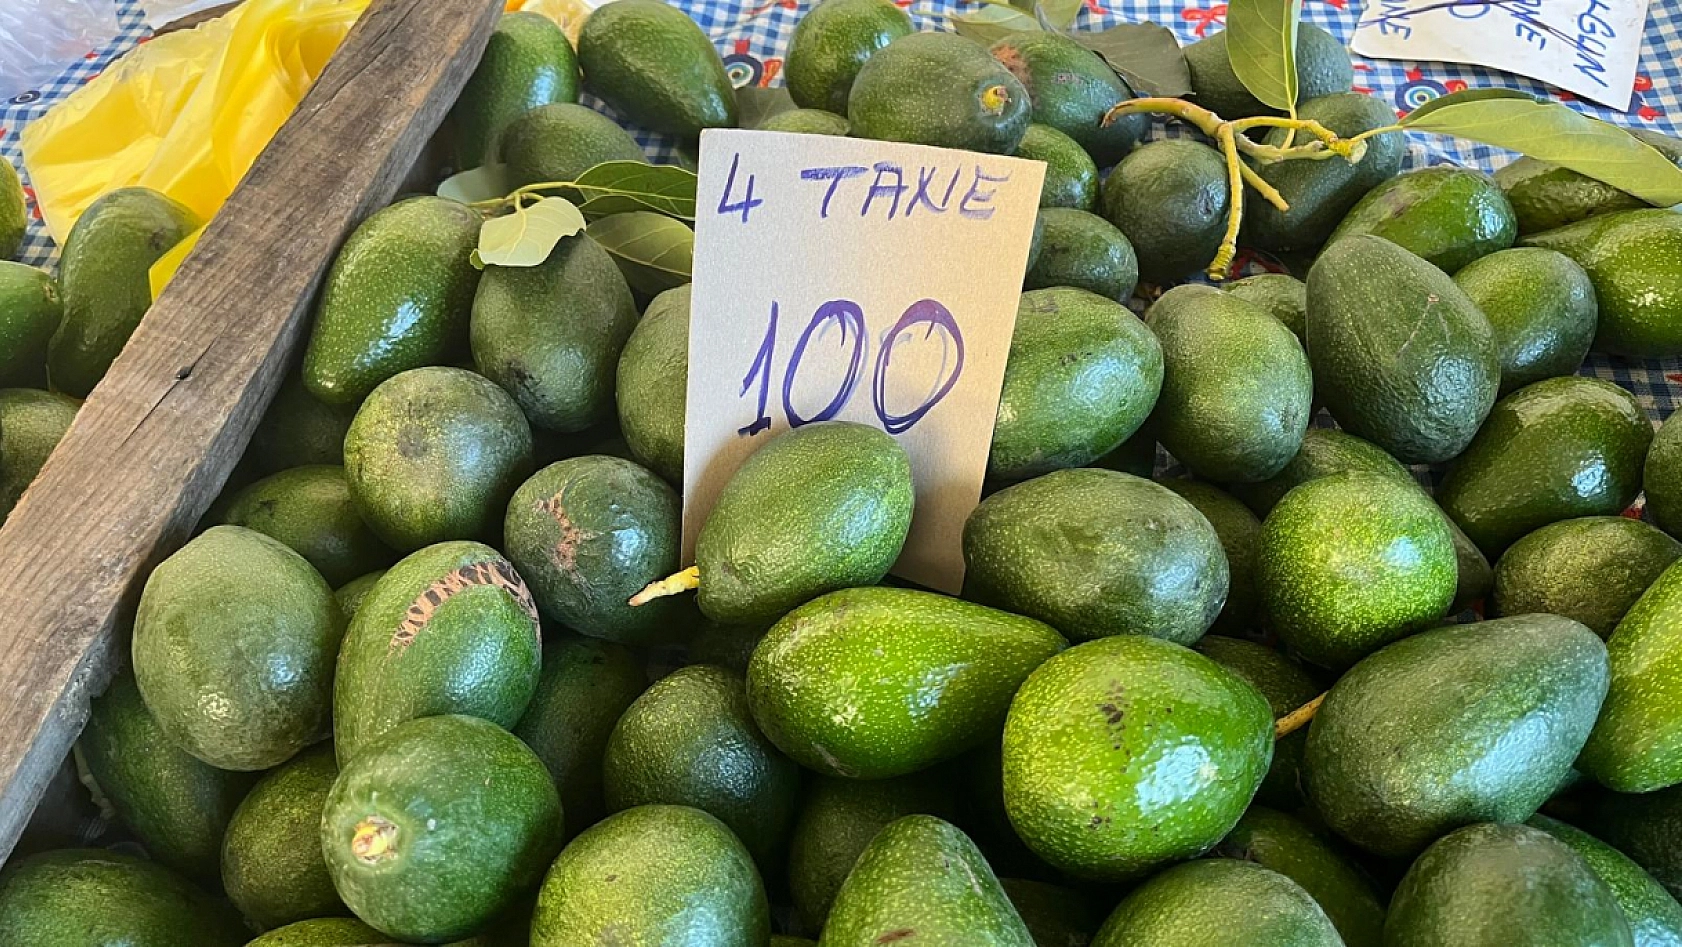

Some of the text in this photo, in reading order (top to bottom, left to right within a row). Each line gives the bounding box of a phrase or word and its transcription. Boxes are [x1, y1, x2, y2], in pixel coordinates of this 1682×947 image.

[1573, 0, 1616, 88] LGUN
[718, 153, 763, 224] 4
[738, 299, 965, 436] 100
